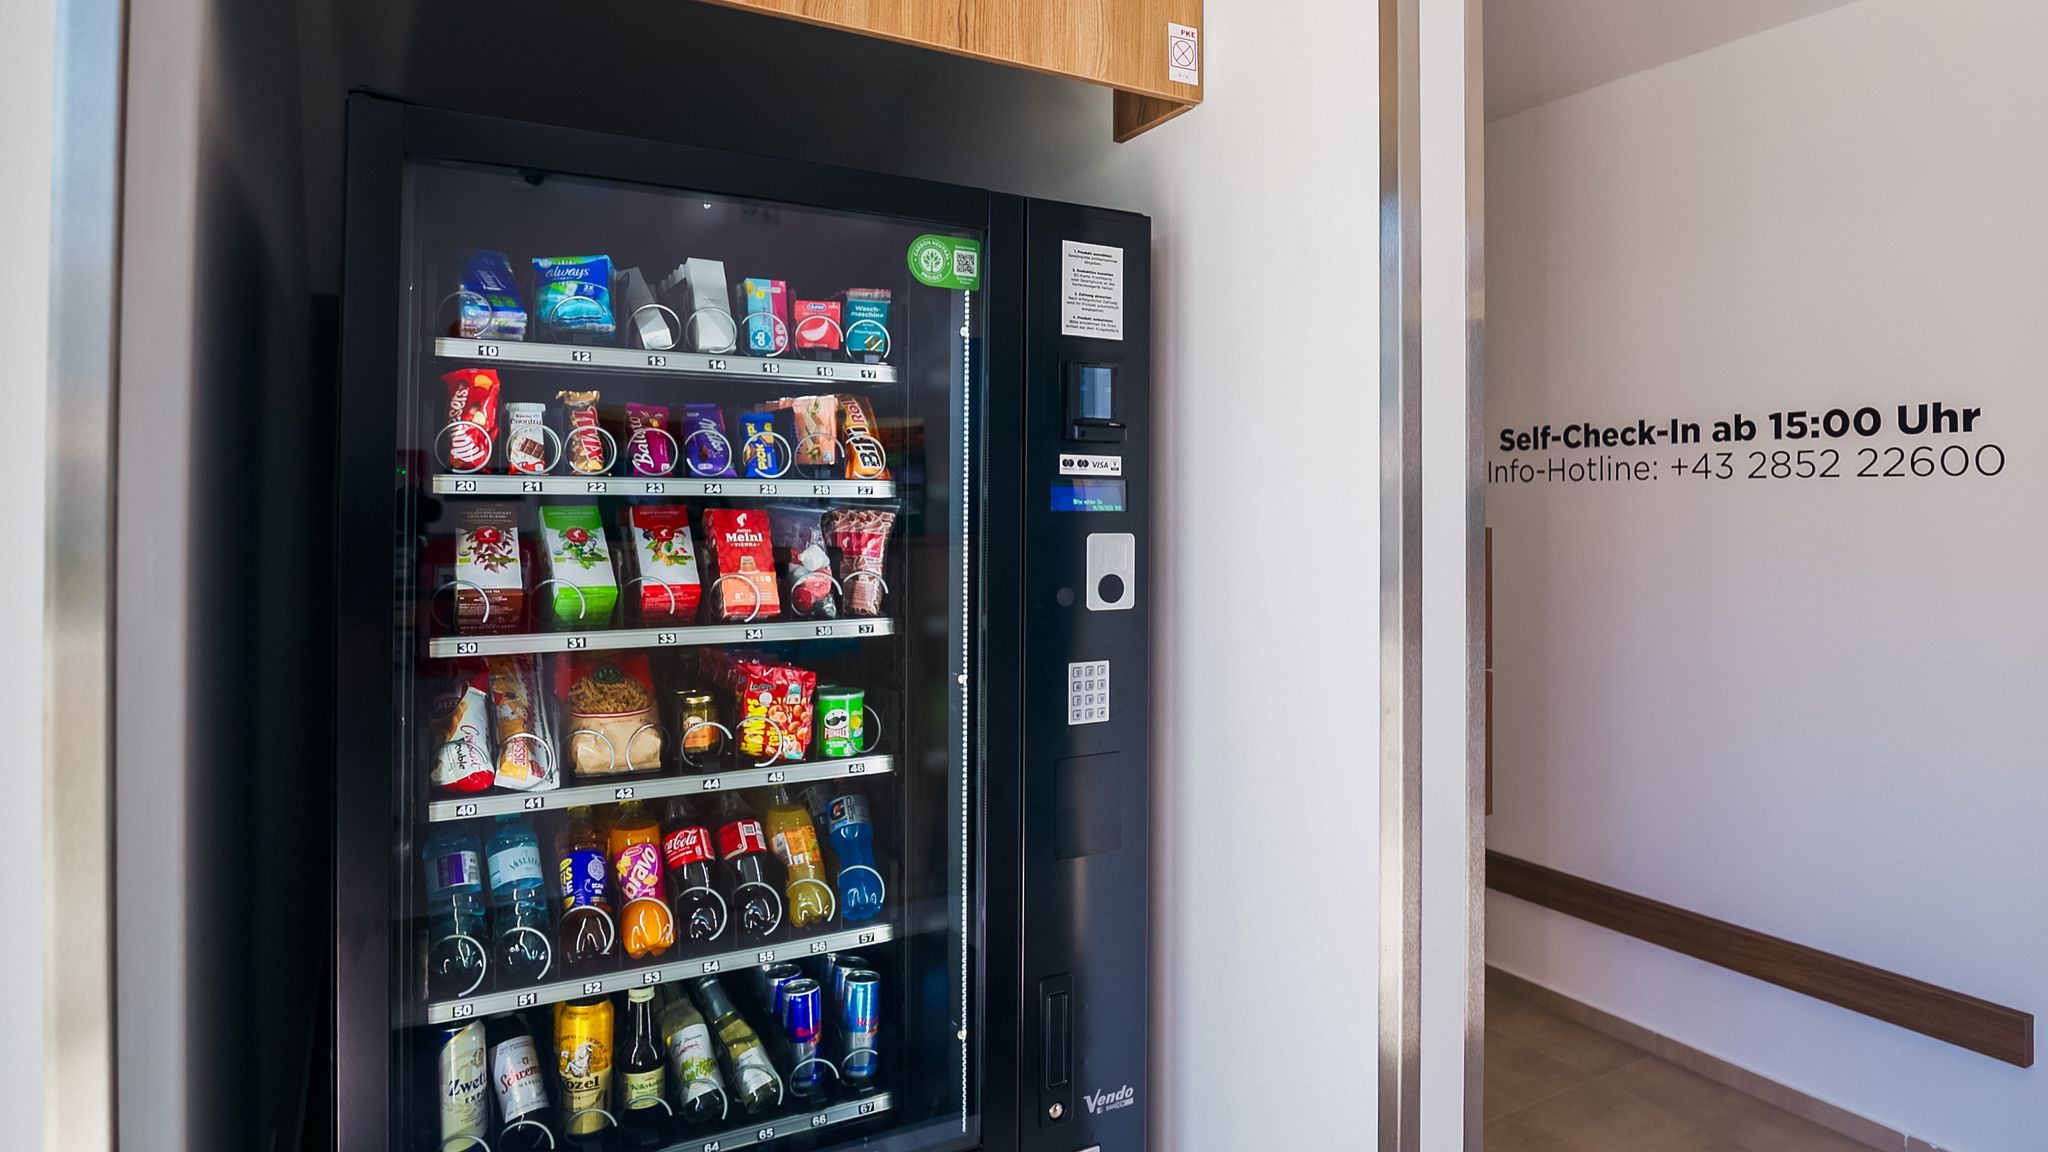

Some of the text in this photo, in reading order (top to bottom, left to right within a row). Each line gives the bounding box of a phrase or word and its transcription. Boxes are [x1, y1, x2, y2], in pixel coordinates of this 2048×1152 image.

[1181, 30, 1196, 38] PKE
[545, 264, 590, 282] always
[851, 311, 884, 319] maschine
[855, 305, 881, 313] Wasch-
[480, 346, 876, 378] 10 12 13 14 15 16 17
[1498, 402, 1981, 453] Self-Check-In ab 15:00 Uhr
[1092, 461, 1109, 469] VISA
[1487, 445, 2005, 485] Info-Hotline: +43 2852 22600
[456, 481, 873, 495] 20 21 22 23 24 25 26 27
[726, 532, 763, 542] Meinl
[458, 625, 873, 653] 30 31 33 34 36 37
[458, 764, 864, 815] 40 41 42 44 45 46
[624, 847, 657, 899] bravo
[454, 934, 874, 1015] 50 51 52 53 54 55 56 57
[1083, 1085, 1134, 1113] Vendo
[704, 1104, 874, 1152] 64 65 66 67
